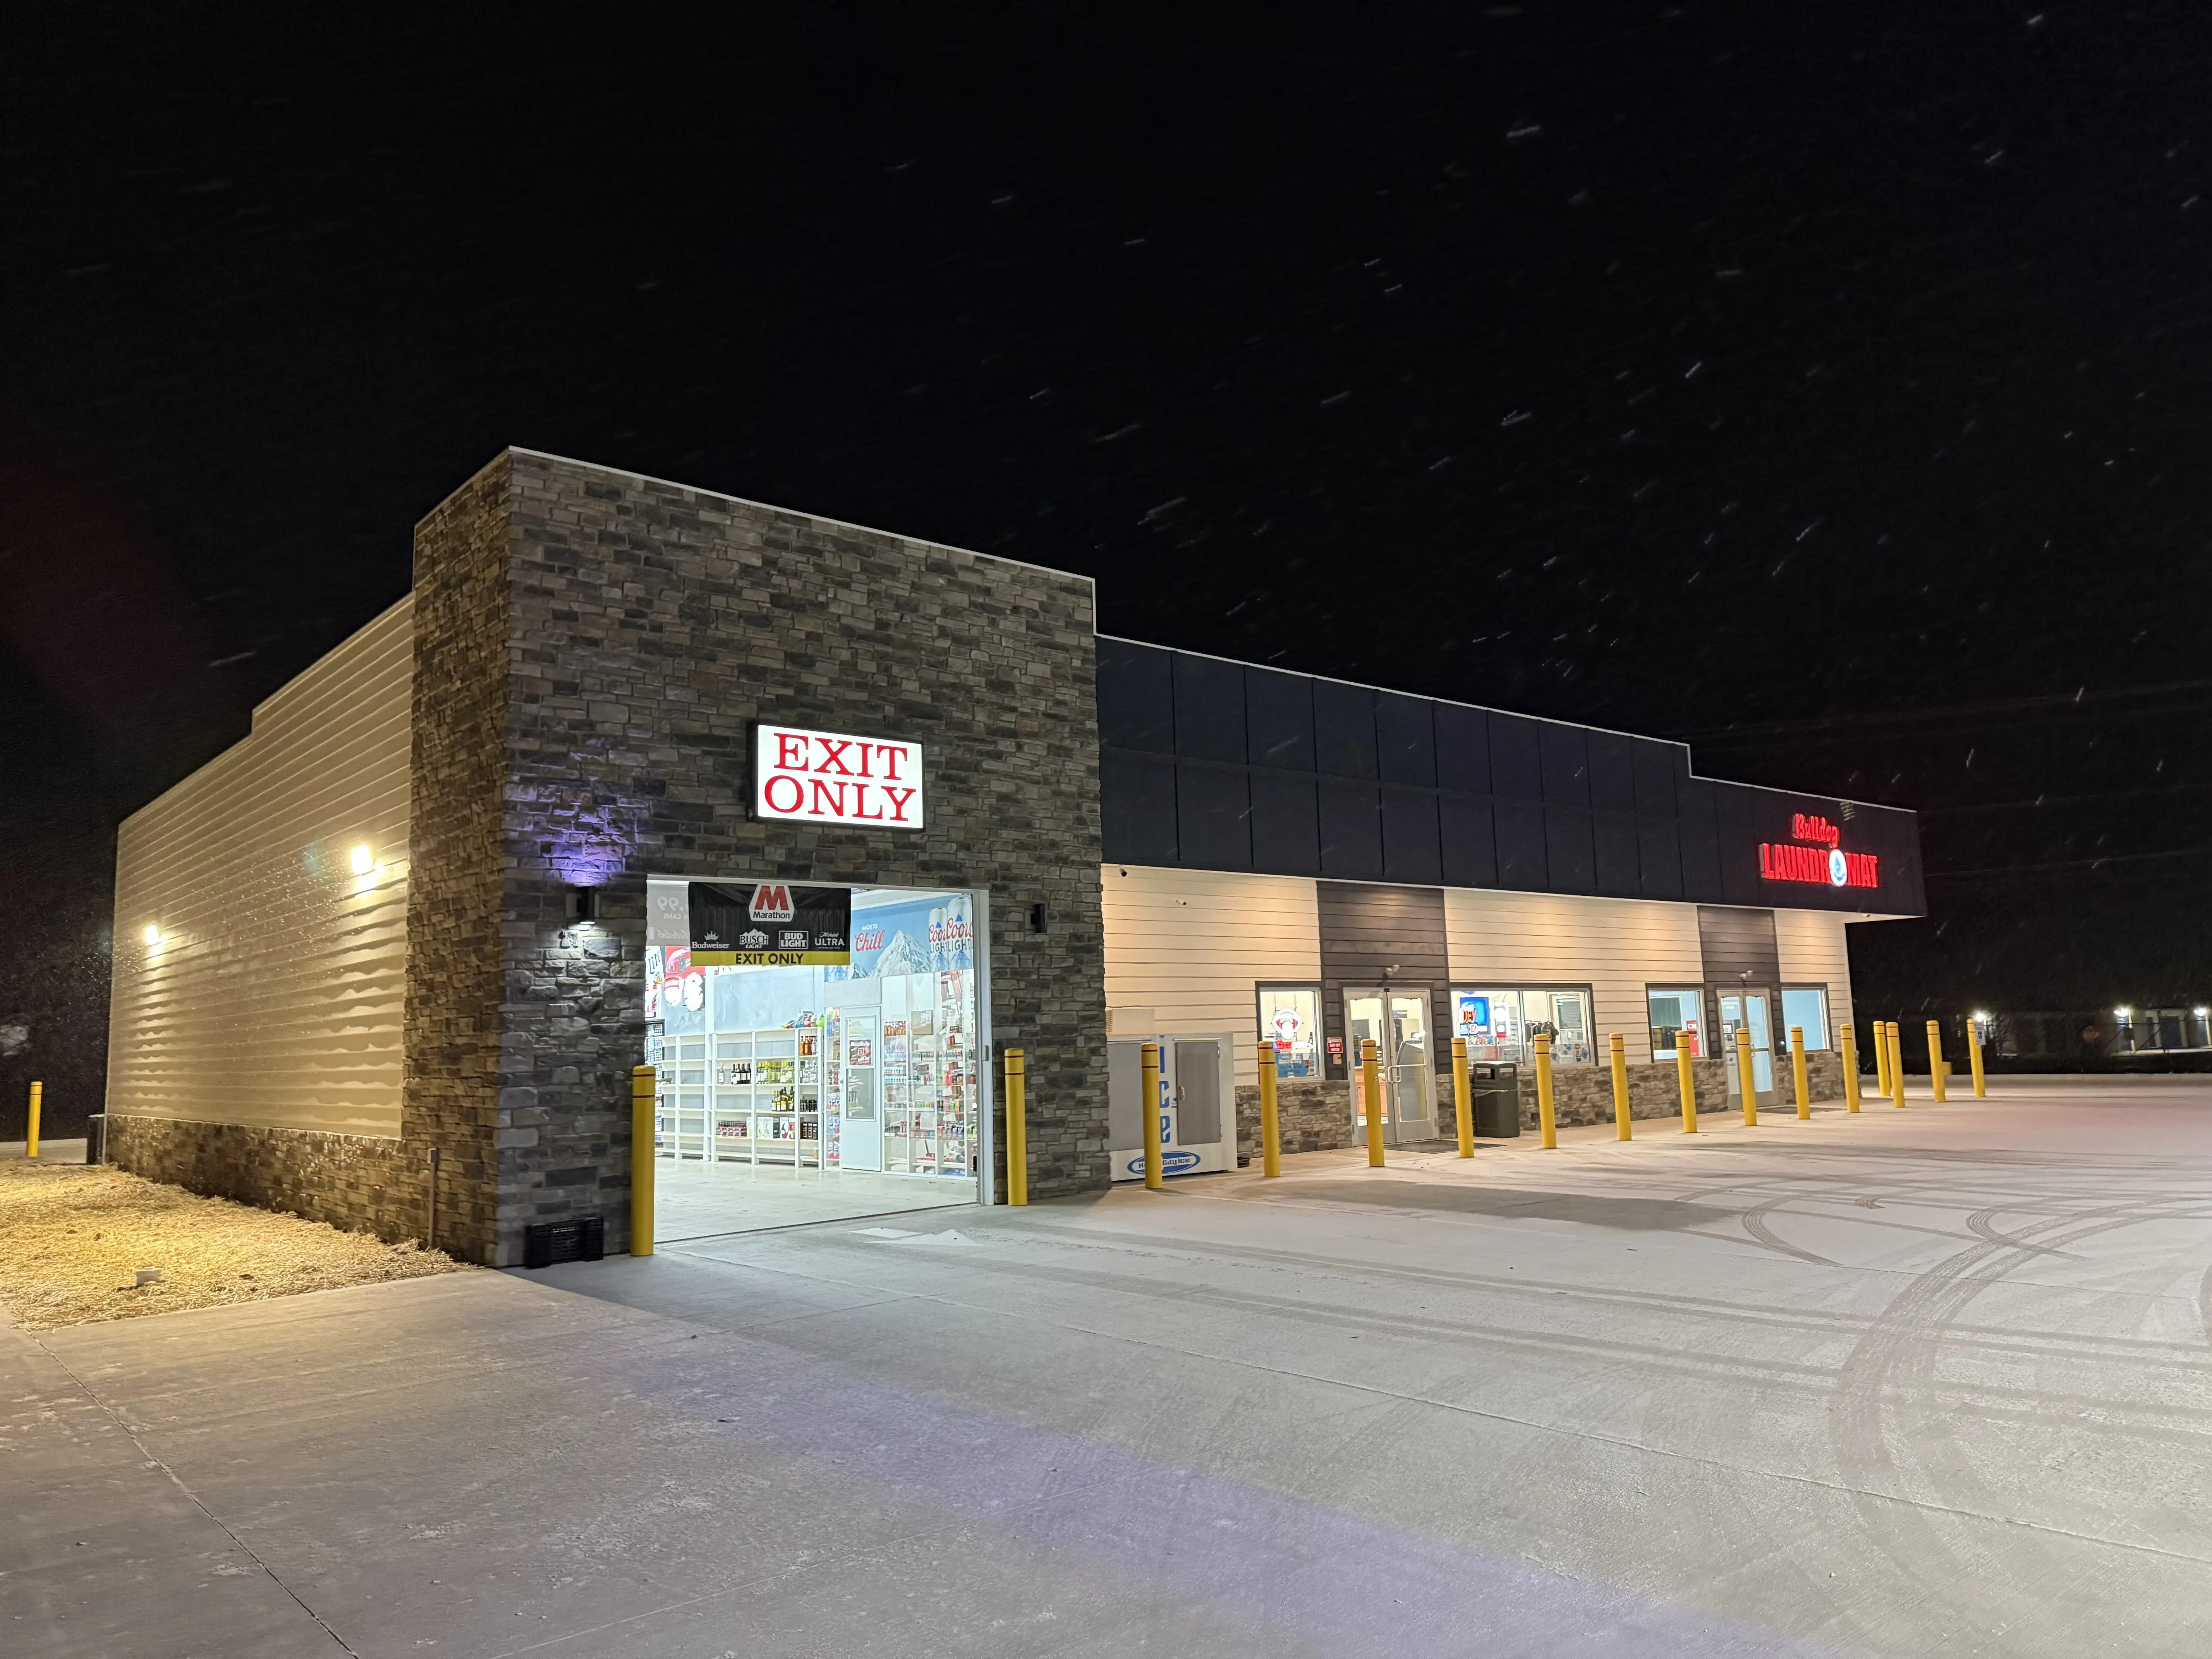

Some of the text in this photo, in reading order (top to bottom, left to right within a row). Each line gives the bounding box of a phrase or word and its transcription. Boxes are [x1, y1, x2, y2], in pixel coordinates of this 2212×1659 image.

[773, 733, 907, 780] EXIT
[764, 775, 916, 821] ONLY
[740, 935, 769, 945] BUSCH
[855, 930, 885, 952] Chill
[929, 925, 946, 943] Coor
[948, 939, 970, 951] LIGHT
[735, 953, 804, 964] EXIT ONLY
[1159, 1046, 1170, 1143] Ice
